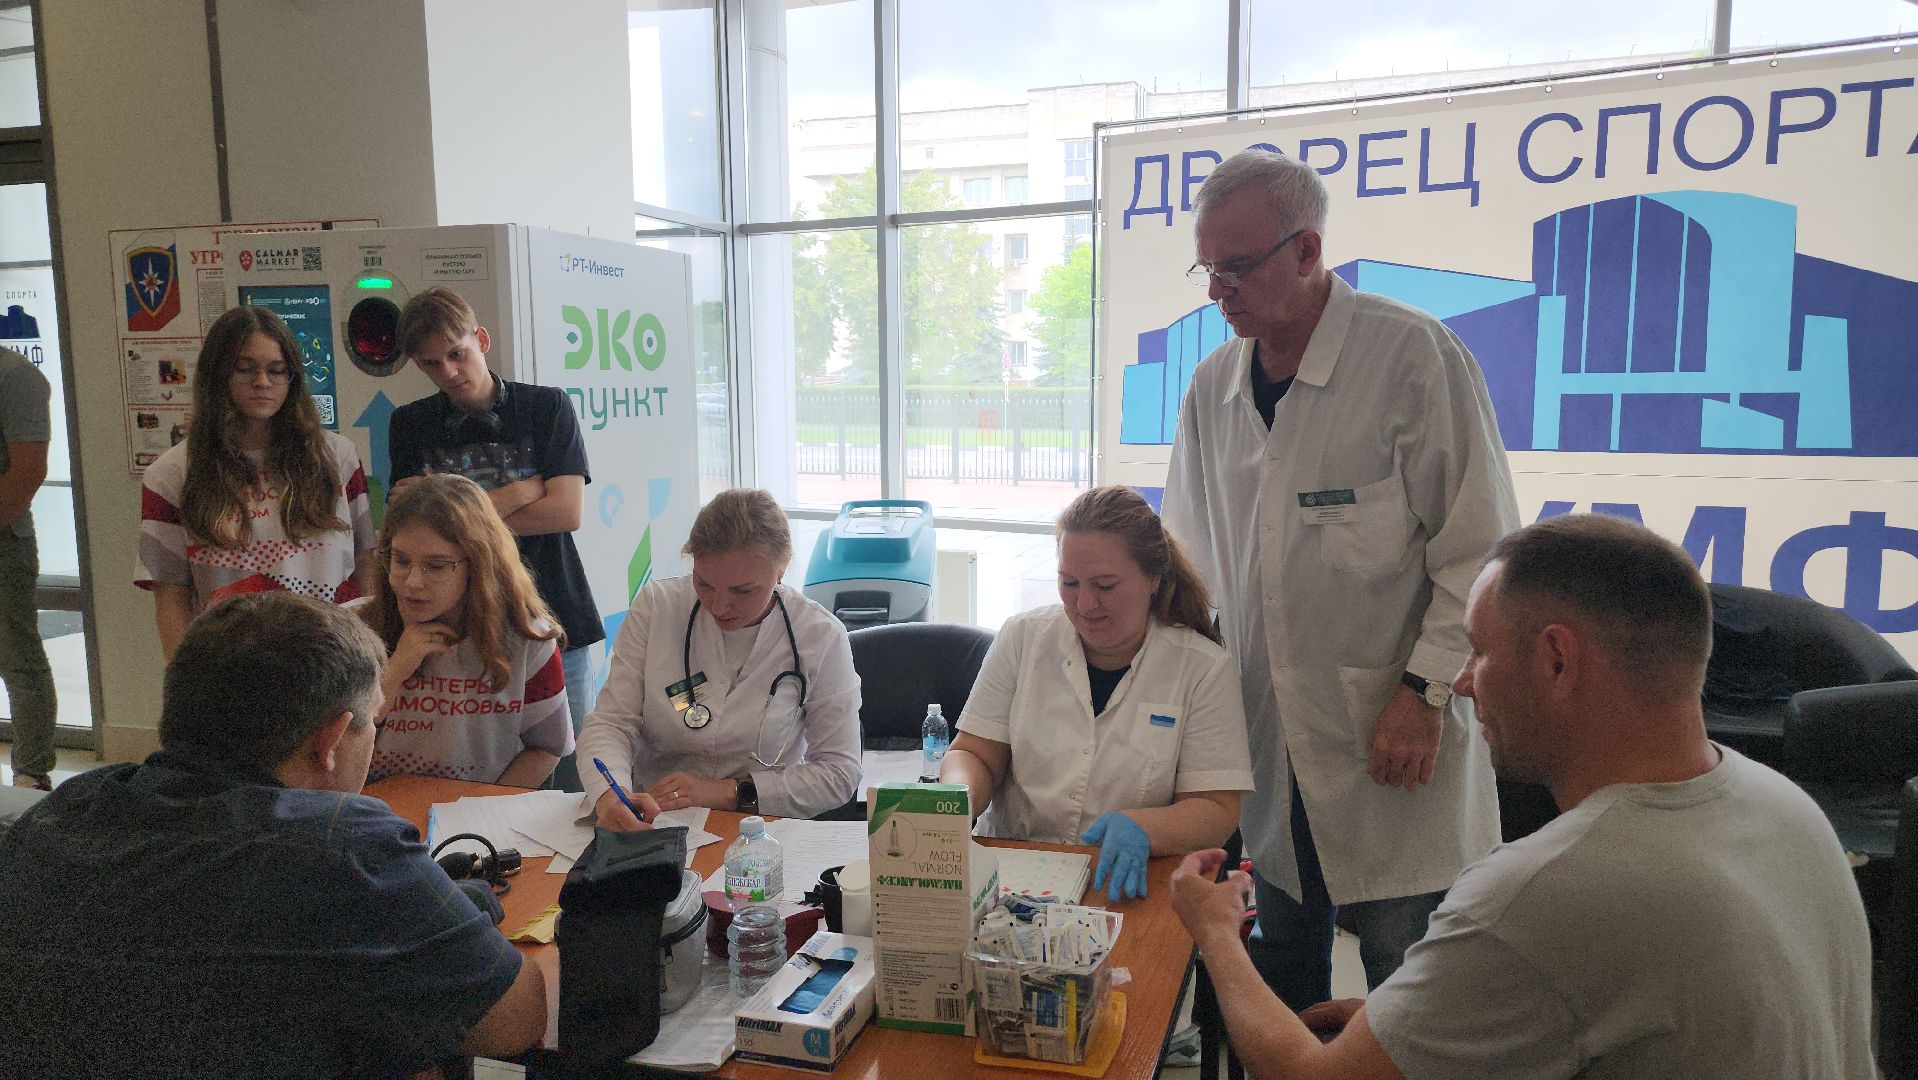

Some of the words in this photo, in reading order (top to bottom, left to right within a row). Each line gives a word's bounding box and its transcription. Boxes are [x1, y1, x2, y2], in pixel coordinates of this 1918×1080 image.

[1123, 122, 1480, 230] ДВРЕЦ
[1517, 77, 1918, 184] СПОРТ
[190, 250, 224, 265] УГР
[255, 248, 299, 258] CALMAR
[256, 257, 296, 267] MARKET
[572, 257, 625, 278] РТ-Инвест
[561, 304, 667, 373] ЭКО
[385, 719, 433, 734] ЯДОМ
[936, 801, 961, 814] 200
[929, 850, 962, 863] FLOW
[911, 861, 962, 875] NORMAL
